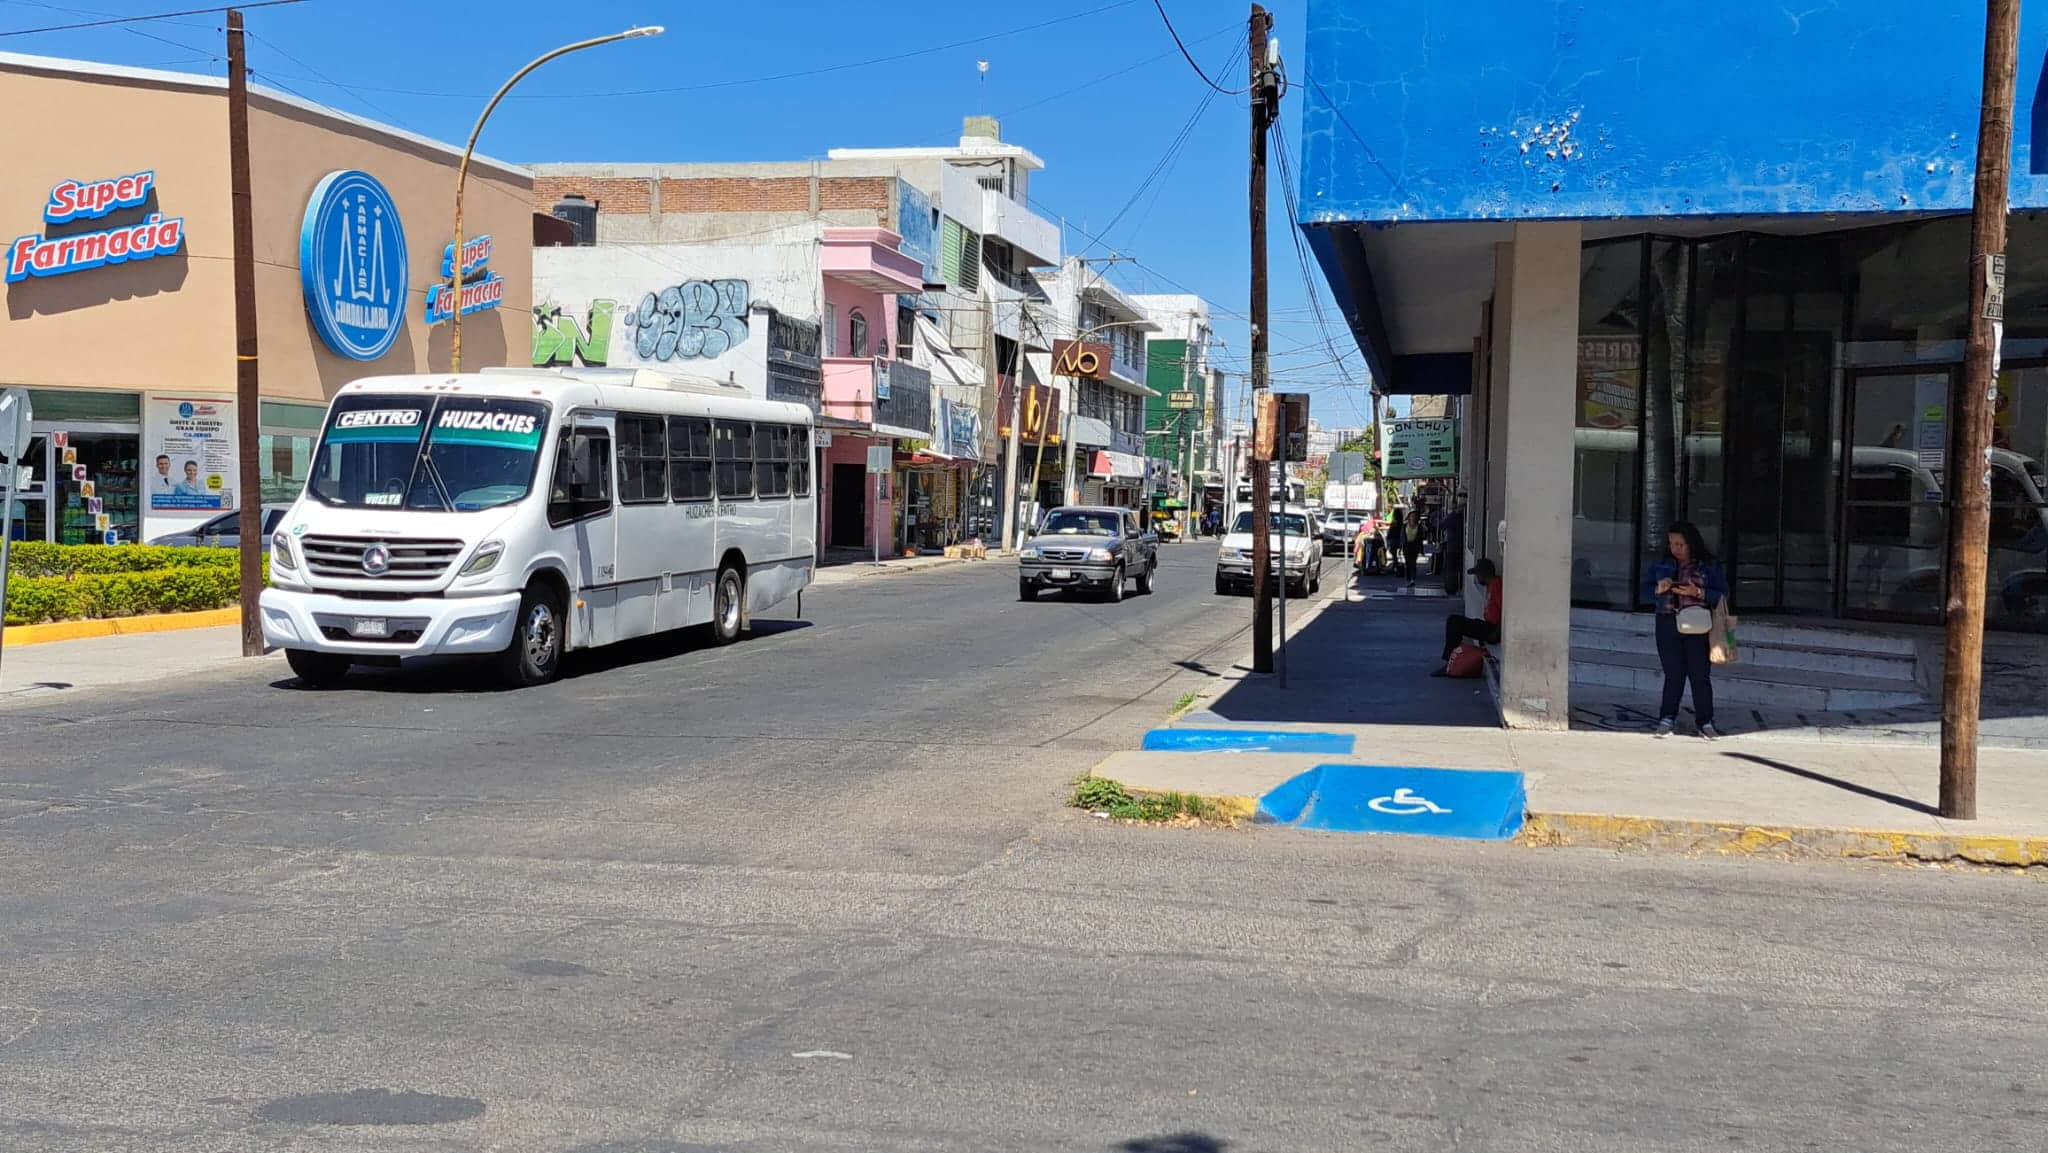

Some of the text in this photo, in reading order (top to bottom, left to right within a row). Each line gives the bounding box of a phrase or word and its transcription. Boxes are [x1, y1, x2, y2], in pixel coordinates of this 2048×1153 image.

[48, 172, 152, 216] Super
[11, 213, 181, 275] Farmacia
[356, 194, 367, 289] FARMACIAS
[435, 275, 503, 315] Famacia
[335, 300, 389, 330] GUADALAJARA
[340, 412, 417, 426] CENTRO
[438, 410, 536, 434] HUIZACHES
[1386, 421, 1412, 436] DON
[1416, 420, 1450, 433] CHUY
